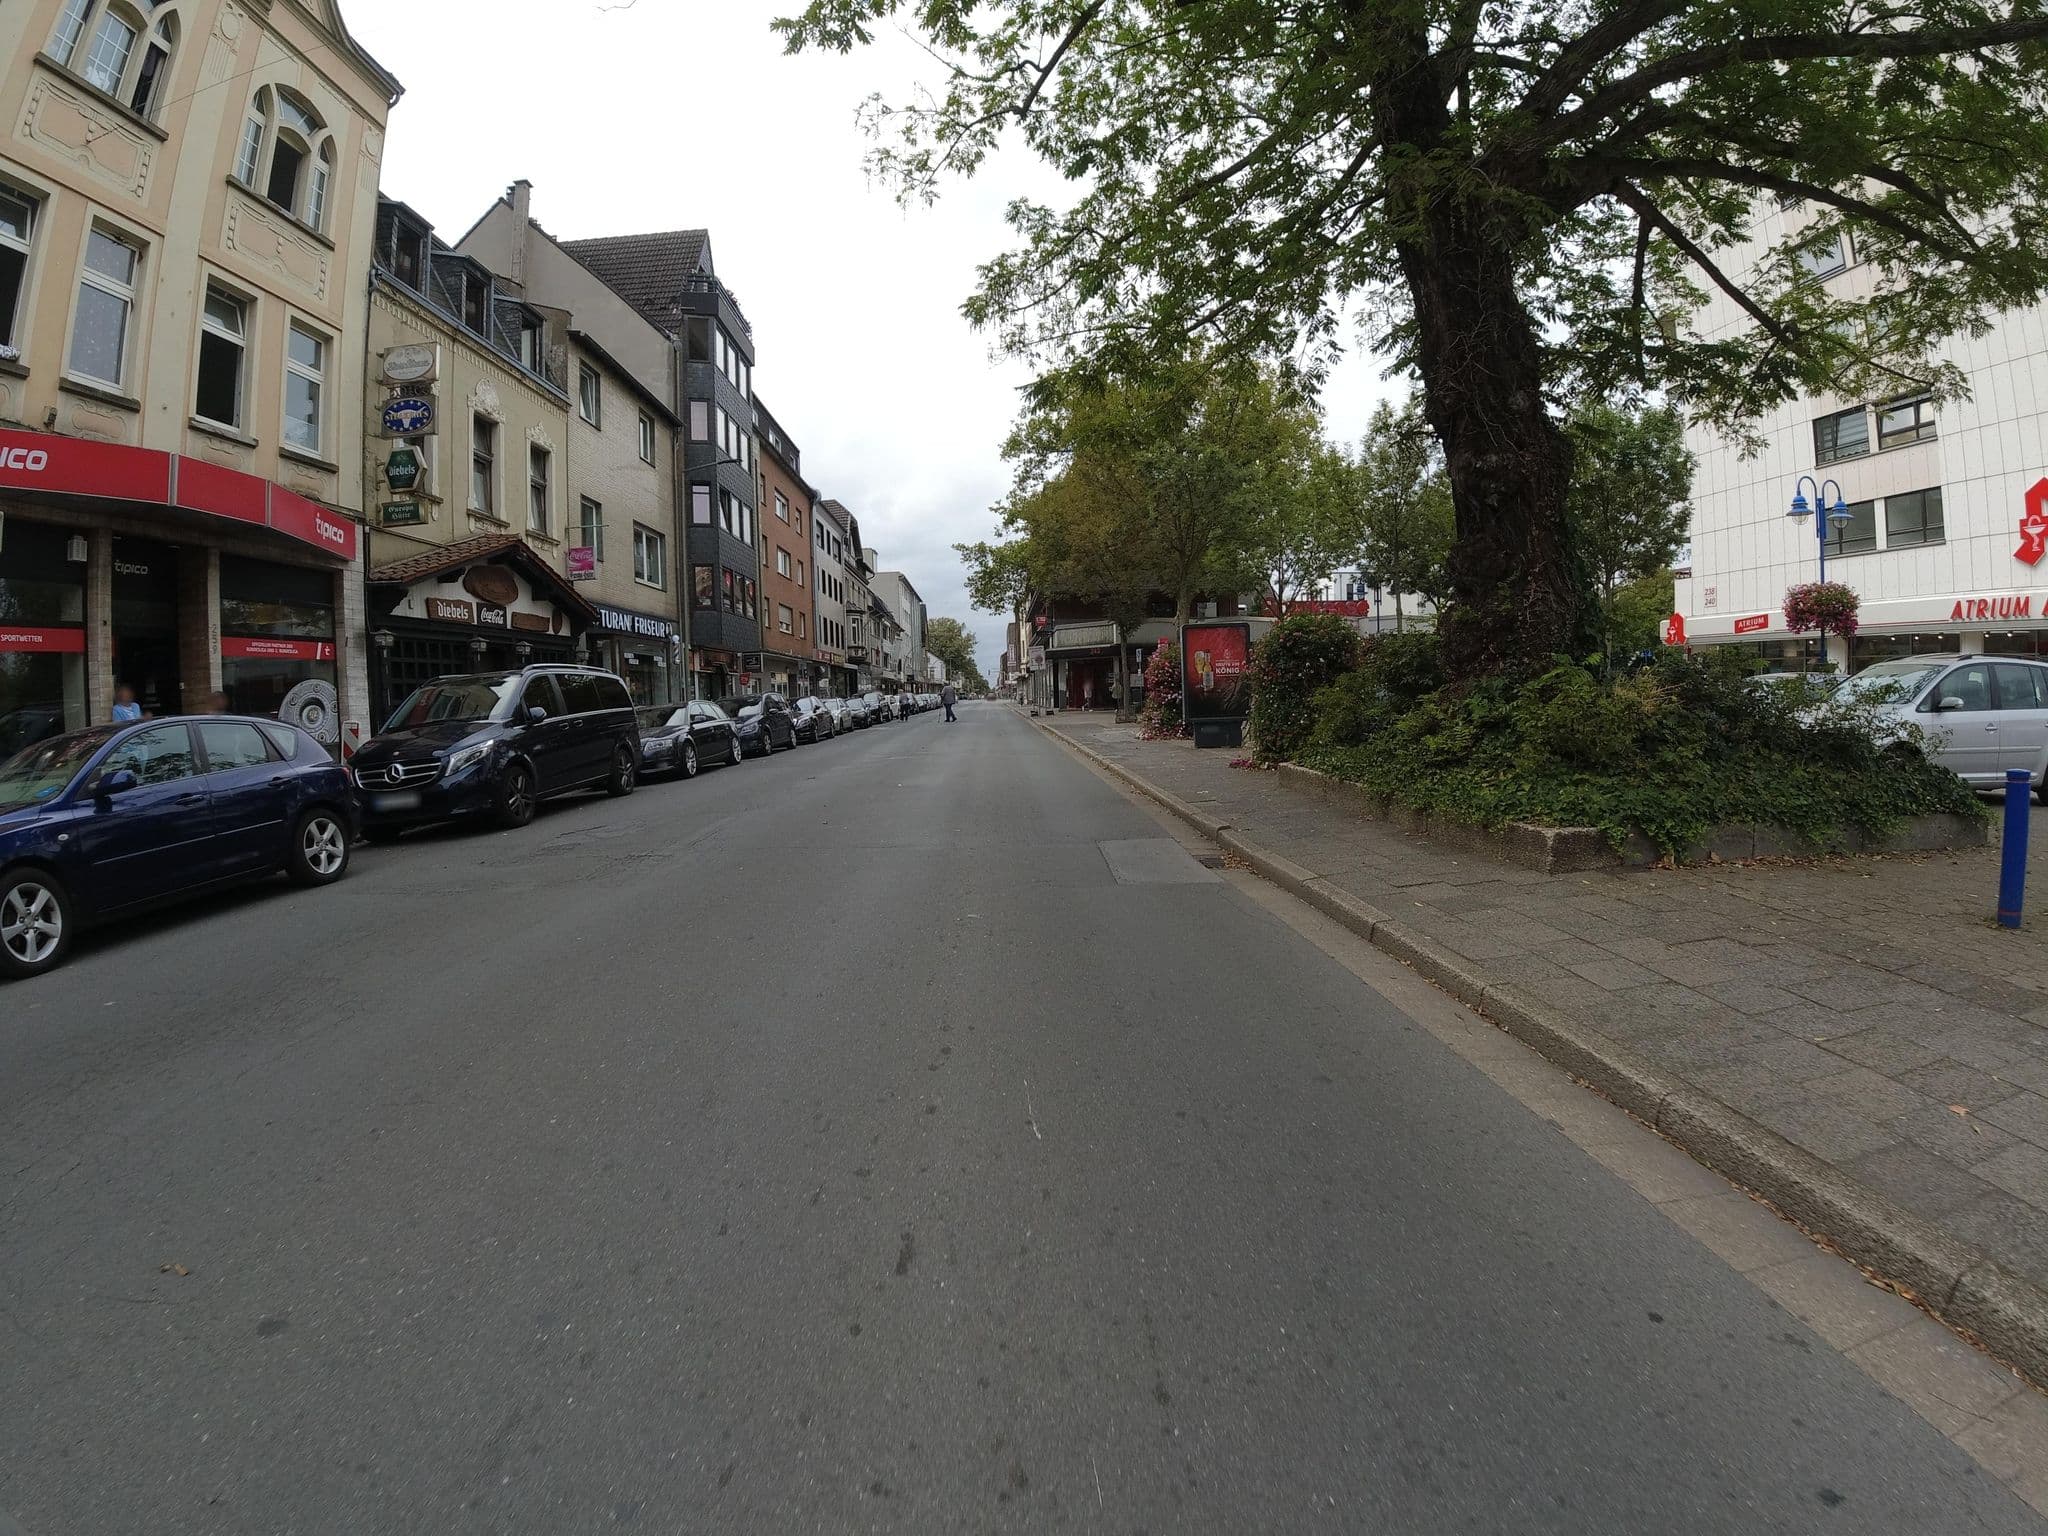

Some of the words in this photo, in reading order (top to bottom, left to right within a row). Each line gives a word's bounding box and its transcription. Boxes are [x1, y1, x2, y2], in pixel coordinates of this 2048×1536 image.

[389, 464, 416, 476] Diebels
[315, 512, 344, 544] tipico
[114, 559, 148, 575] tipico
[437, 600, 469, 619] Diebels
[1950, 595, 2031, 620] ATRIUM
[634, 616, 665, 638] FRISEUR
[1738, 616, 1765, 629] ATRIUM
[0, 634, 43, 643] SPORTWETTEN
